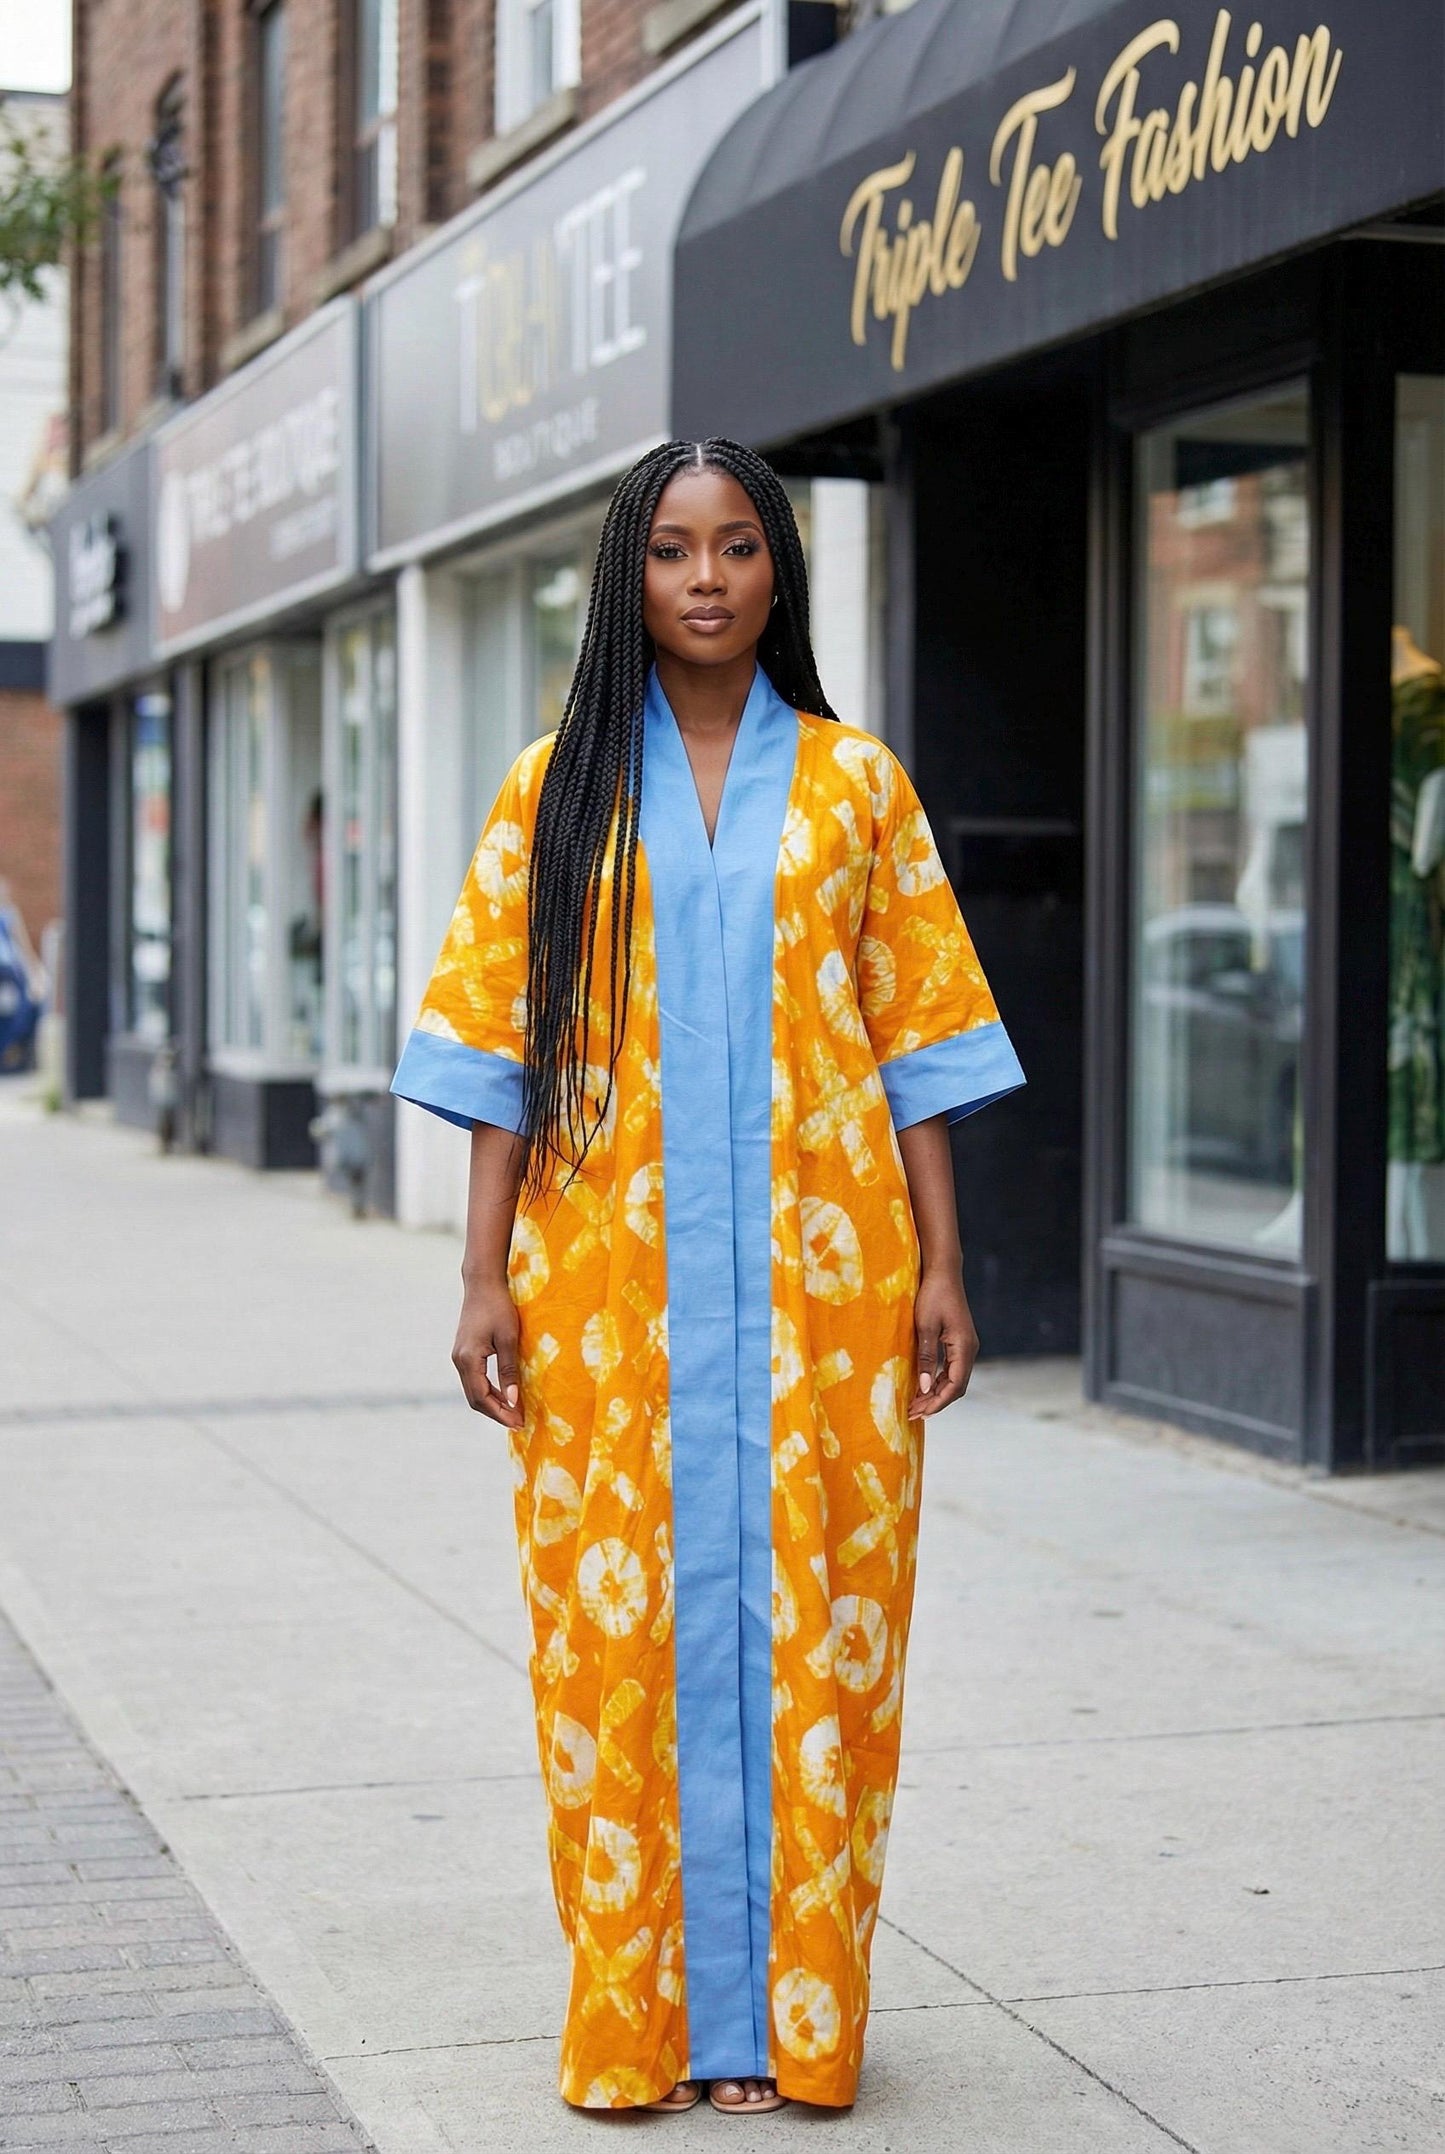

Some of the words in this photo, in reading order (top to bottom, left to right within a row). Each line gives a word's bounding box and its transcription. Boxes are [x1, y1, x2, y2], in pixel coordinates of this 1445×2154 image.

[839, 146, 983, 373] Triple
[989, 65, 1084, 282] Tee
[1094, 7, 1344, 241] Fashion
